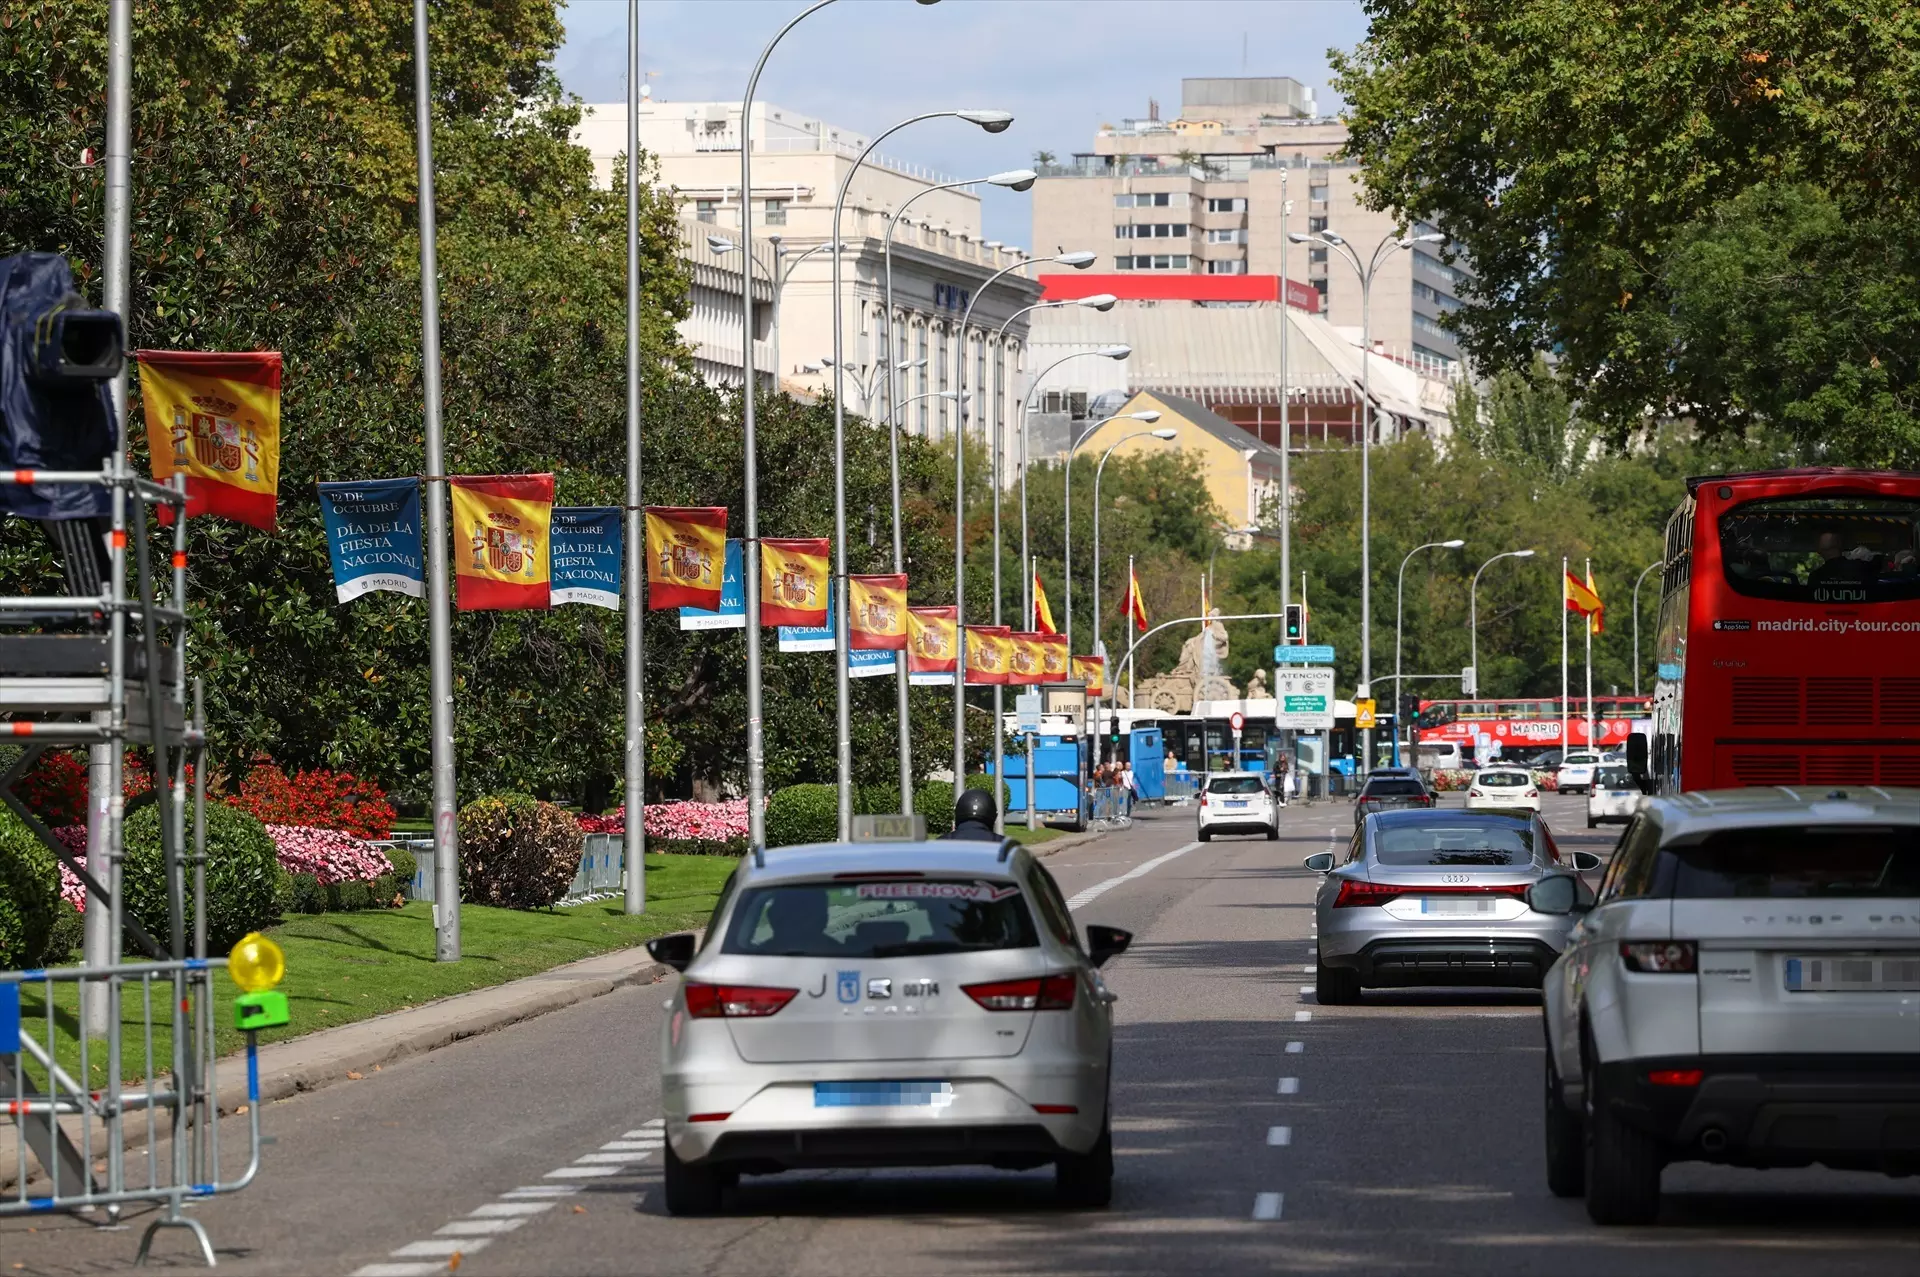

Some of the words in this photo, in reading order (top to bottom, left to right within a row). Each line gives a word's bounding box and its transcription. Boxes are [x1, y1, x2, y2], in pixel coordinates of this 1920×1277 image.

[331, 492, 342, 502] 12
[345, 492, 365, 502] DE
[333, 502, 400, 515] OCTUBRE
[561, 516, 577, 524] DE
[336, 522, 365, 539] DÍA
[368, 522, 391, 534] DE
[393, 521, 413, 535] LA
[551, 525, 604, 535] OCTUBRE
[339, 537, 393, 555] FIESTA
[553, 542, 575, 555] DÍA
[577, 543, 595, 553] DE
[597, 544, 614, 555] LA
[342, 552, 420, 571] NACIONAL
[553, 556, 596, 569] FIESTA
[555, 569, 617, 584] NACIONAL
[373, 579, 408, 589] MADRID
[576, 592, 605, 602] MADRID
[784, 626, 832, 635] NACIONAL
[851, 652, 892, 662] NACIONAL
[1054, 705, 1063, 713] LA
[1513, 723, 1561, 736] MADRID
